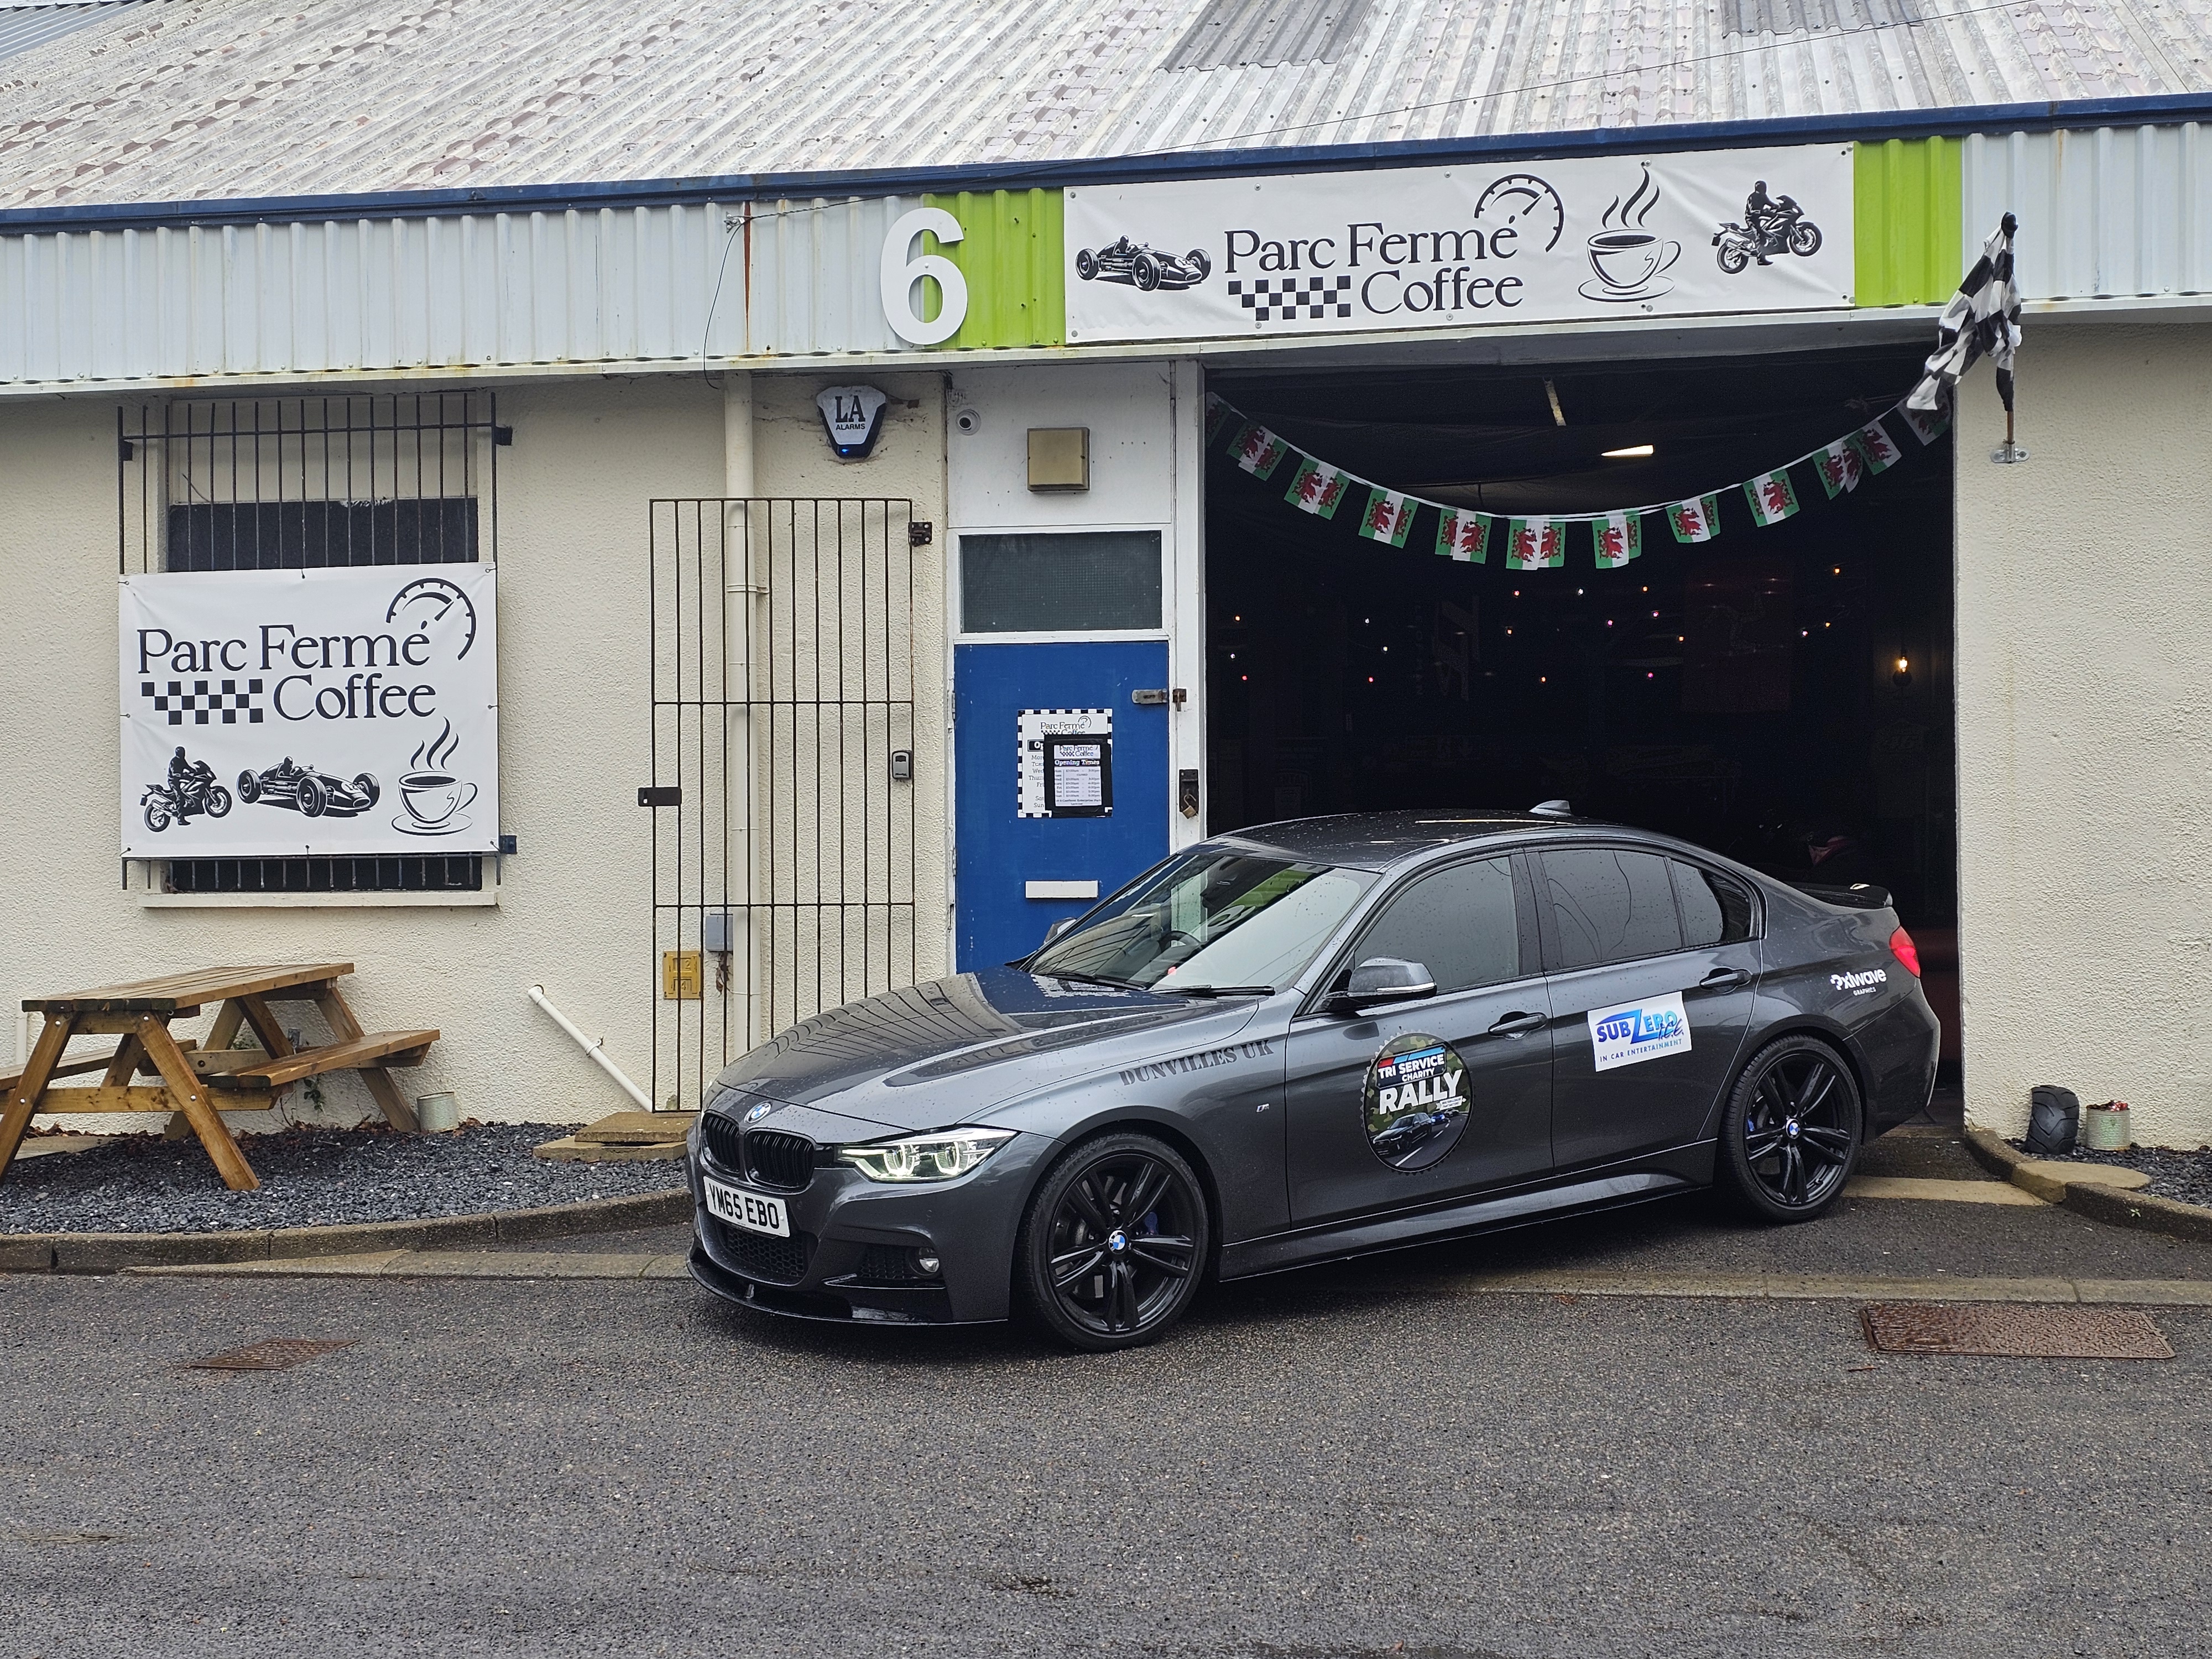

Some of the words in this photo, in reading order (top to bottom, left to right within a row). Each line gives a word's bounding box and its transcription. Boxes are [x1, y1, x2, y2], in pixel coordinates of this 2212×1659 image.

[1224, 229, 1336, 274] Parc
[1347, 215, 1519, 268] Fermé
[880, 207, 968, 345] 6
[1361, 266, 1524, 315] Coffee
[835, 395, 865, 422] LA
[137, 628, 247, 674] Parc
[259, 620, 431, 671] Fermé
[273, 673, 436, 721] Coffee
[1118, 1047, 1238, 1086] DUNVILLES
[1240, 1039, 1275, 1059] UK
[1378, 1065, 1397, 1079] TRI
[1398, 1053, 1445, 1074] SERVICE
[1627, 1039, 1682, 1056] ENTERTAINMENT
[1379, 1069, 1463, 1115] RALLY
[1401, 1067, 1435, 1082] CHARITY
[708, 1182, 743, 1220] YM65
